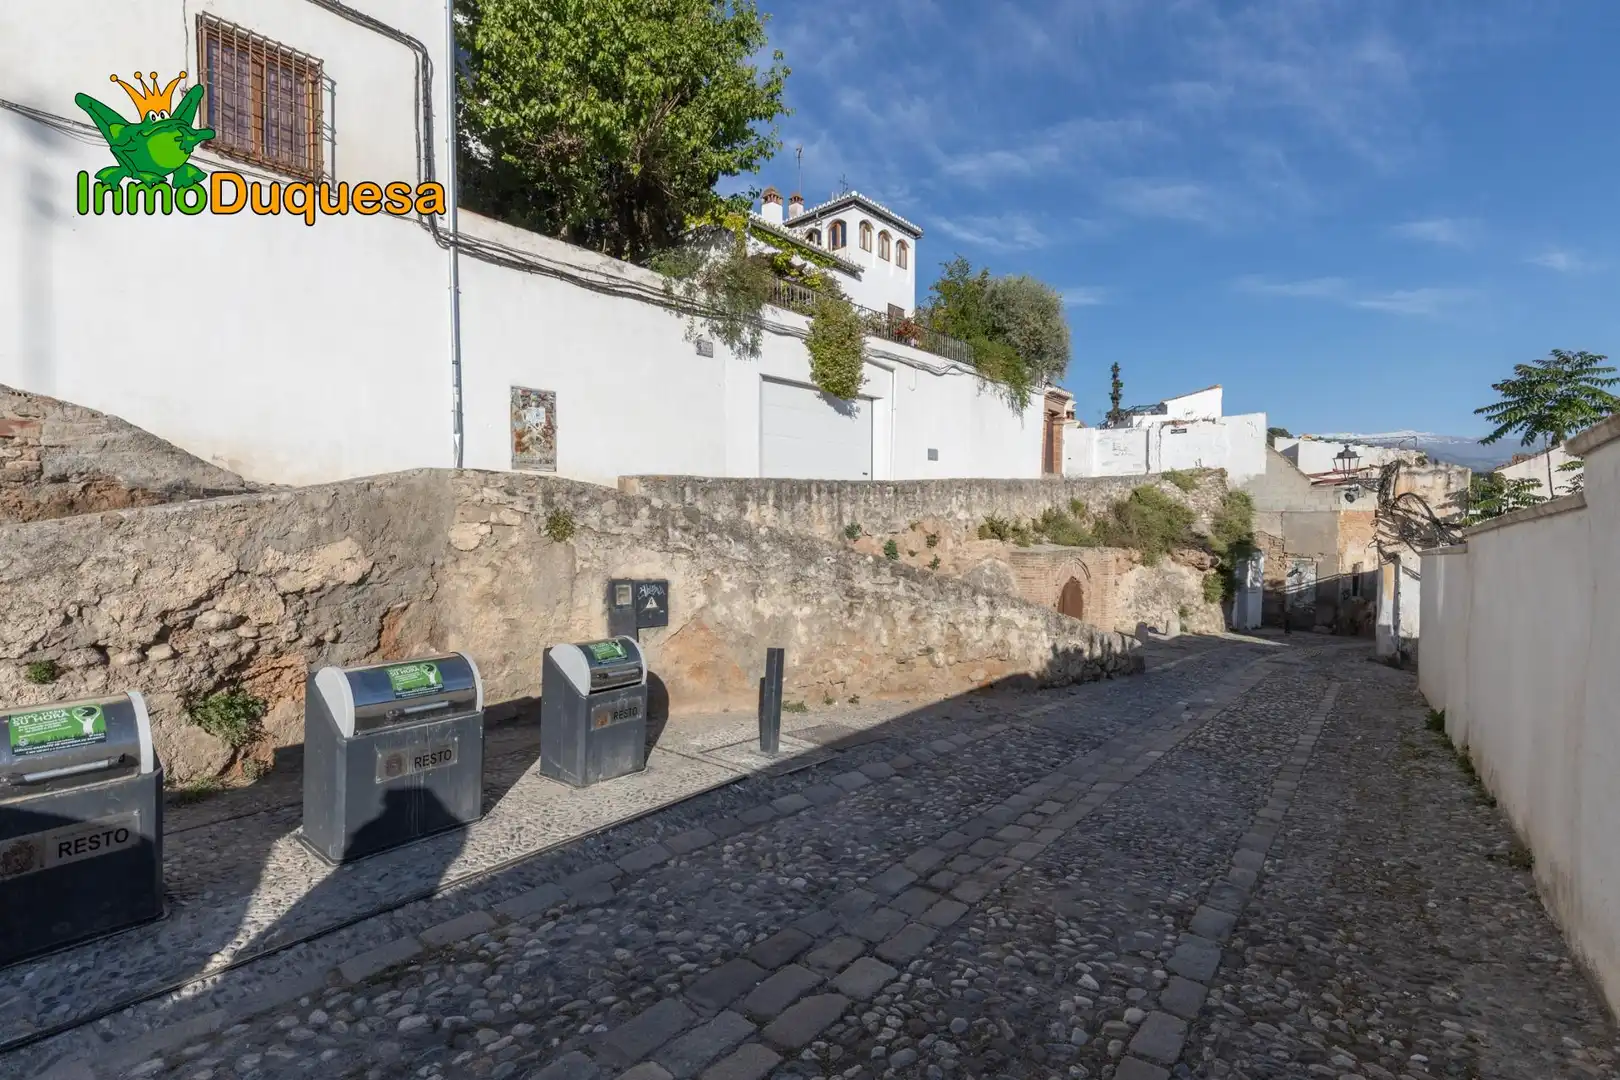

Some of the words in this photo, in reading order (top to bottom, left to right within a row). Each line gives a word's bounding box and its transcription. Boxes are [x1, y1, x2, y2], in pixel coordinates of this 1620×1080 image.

[613, 707, 638, 720] RESTO
[414, 749, 452, 769] RESTO
[58, 828, 130, 859] RESTO
